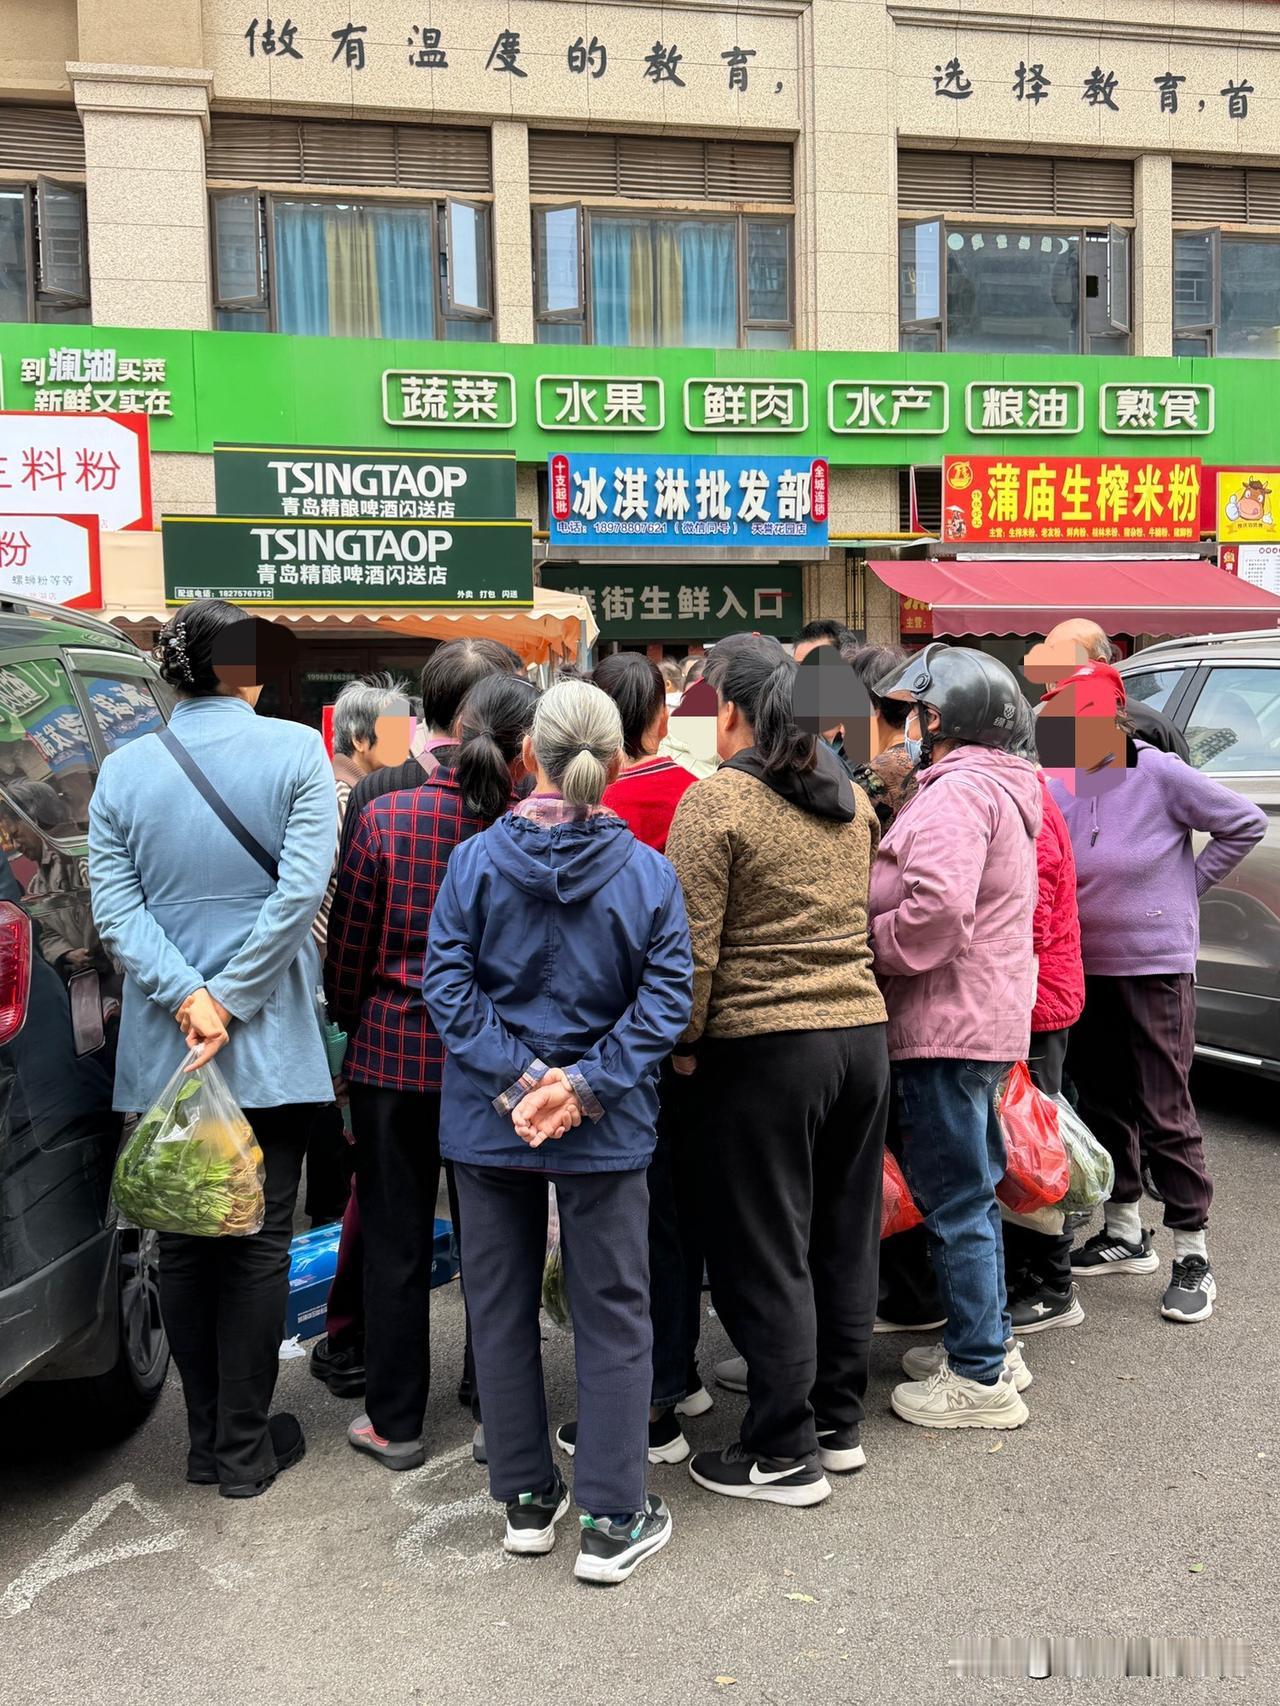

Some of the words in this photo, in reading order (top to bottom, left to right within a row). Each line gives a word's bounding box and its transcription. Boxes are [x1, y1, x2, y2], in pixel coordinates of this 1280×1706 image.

[21, 347, 166, 385] 到澜湖买菜
[34, 387, 173, 416] 新鲜又实在
[401, 377, 499, 420] 蔬菜
[555, 381, 648, 425] 水果
[703, 384, 794, 426] 鲜肉
[846, 387, 933, 427] 水产
[982, 388, 1068, 429] 粮油
[1116, 389, 1199, 429] 熟食
[267, 461, 467, 498] TSINGTAOP
[555, 461, 568, 513] 十支起批
[572, 466, 811, 522] 冰淇淋批发部
[814, 466, 825, 516] 全城连锁
[987, 463, 1199, 522] 蒲庙生榨米粉
[281, 497, 455, 518] 青岛精酿啤酒闪送店
[250, 528, 453, 562] TSINGTAOP
[256, 564, 448, 585] 青岛精酿啤酒闪送店
[457, 590, 473, 598] 外卖
[480, 590, 496, 599] 打包
[502, 590, 518, 598] 闪送
